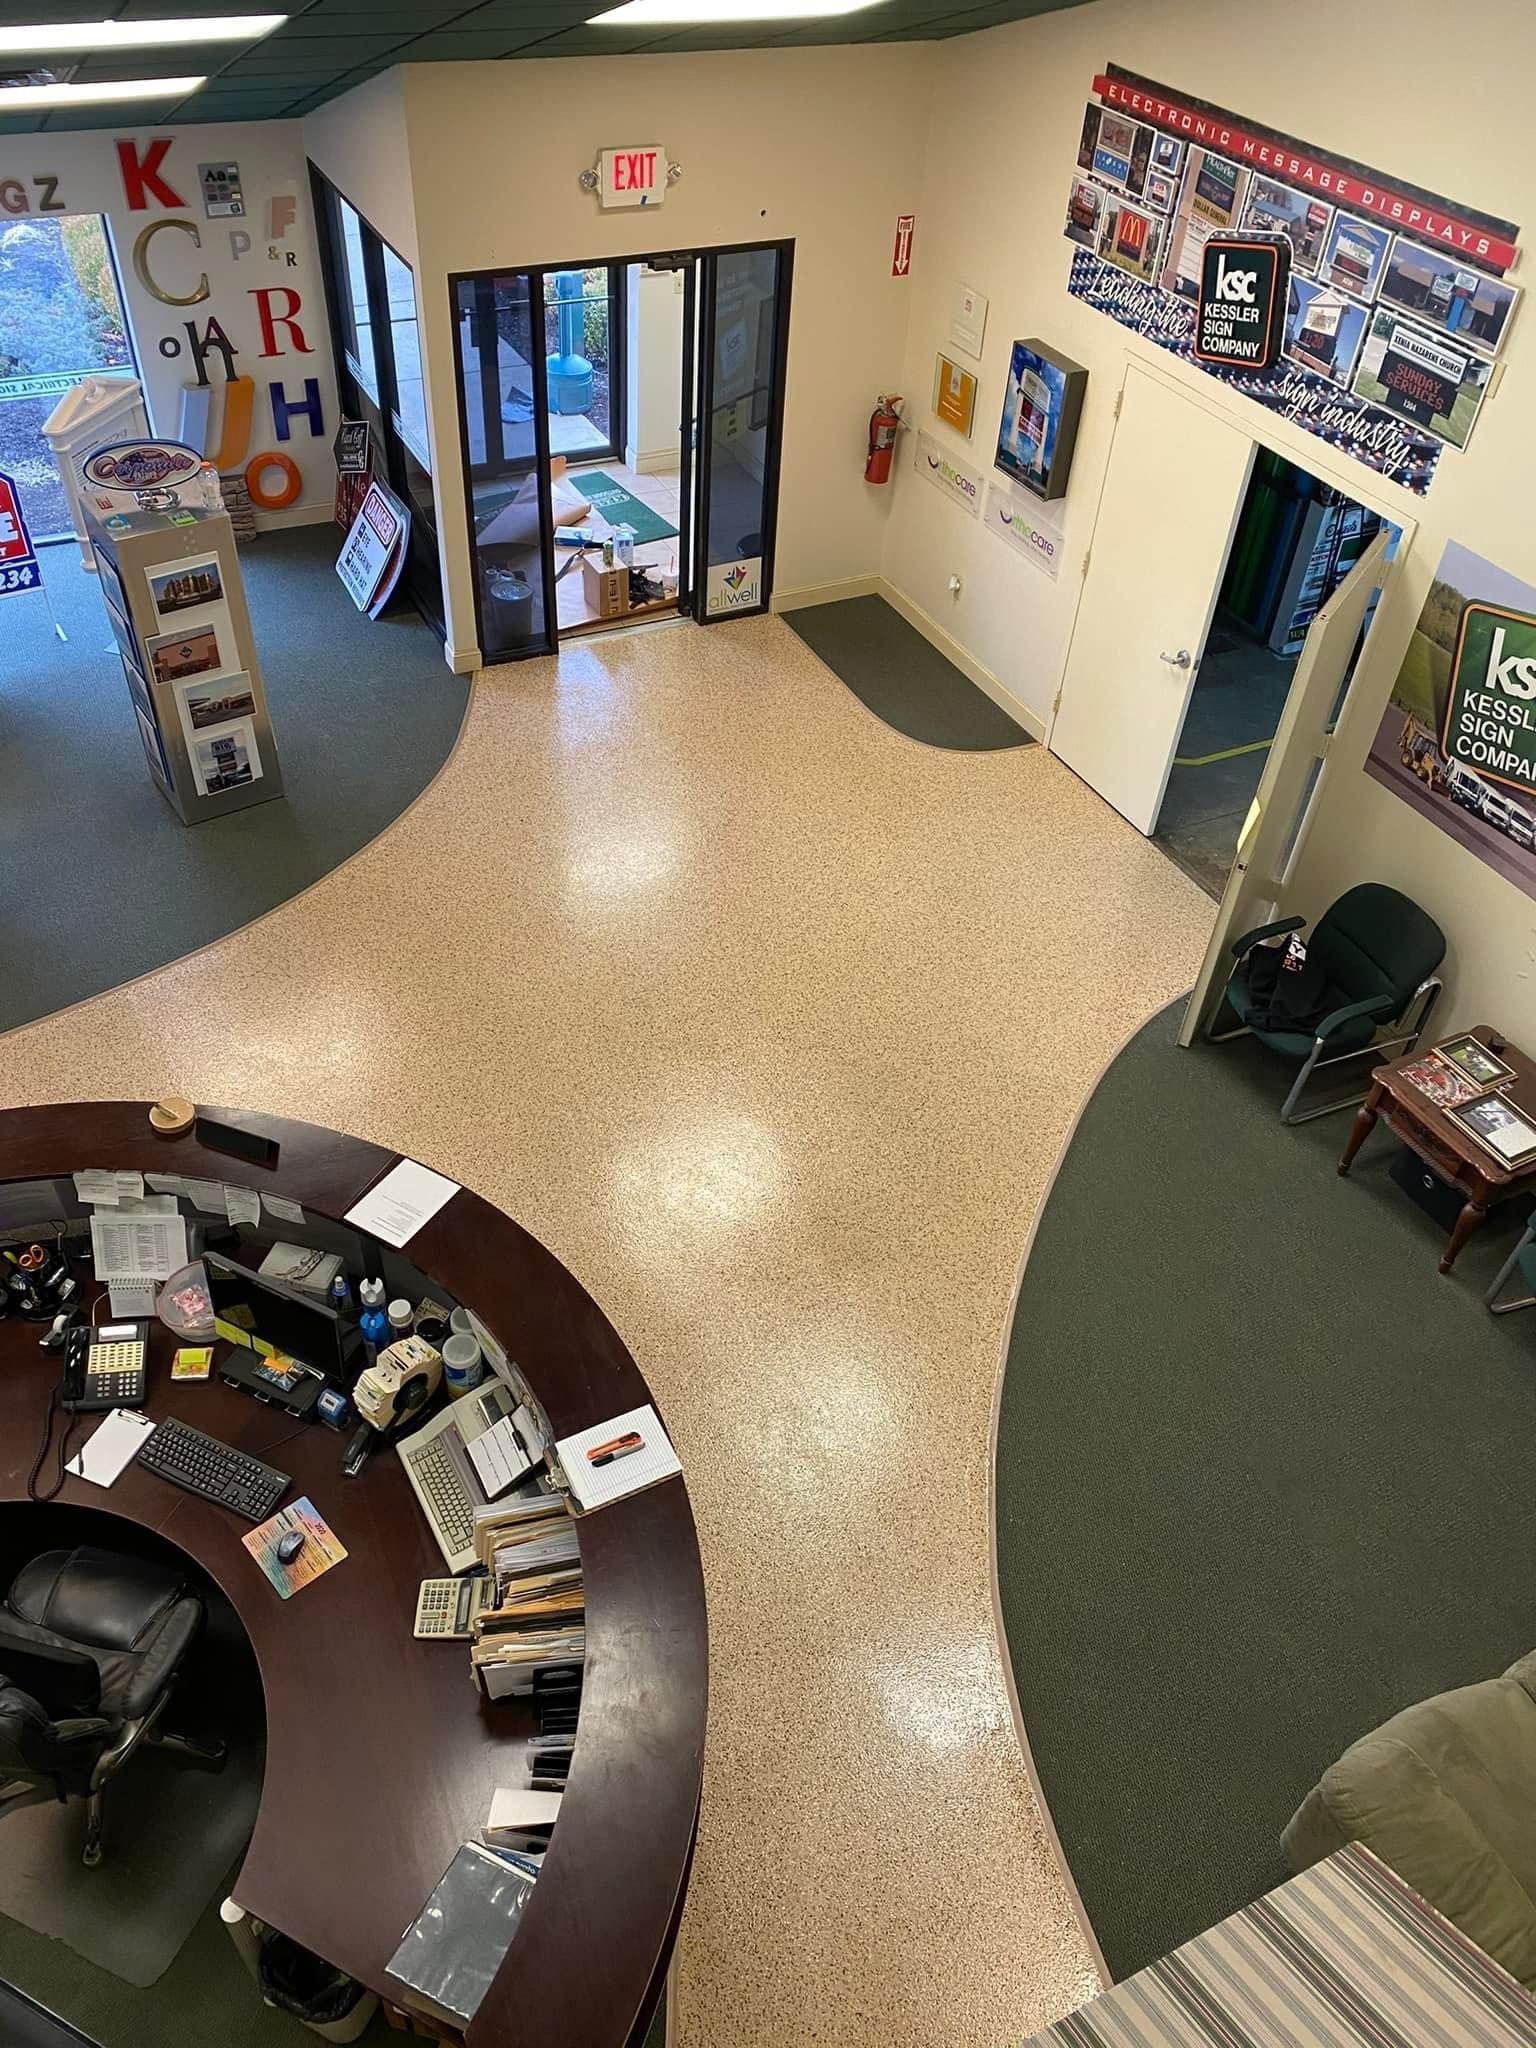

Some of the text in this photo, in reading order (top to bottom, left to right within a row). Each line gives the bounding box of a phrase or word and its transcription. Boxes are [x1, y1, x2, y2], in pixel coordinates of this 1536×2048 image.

[114, 137, 188, 210] K
[613, 152, 657, 191] EXIT
[1109, 83, 1231, 146] ELECTRONIC
[1243, 140, 1348, 196] MESSAGE
[1362, 189, 1491, 255] DISPLAYS
[33, 176, 65, 211] Z
[133, 218, 211, 306] C
[1087, 262, 1188, 337] Leading the
[1204, 302, 1260, 323] KESSLER
[248, 287, 317, 358] R
[1203, 320, 1233, 337] SIGN
[1202, 336, 1260, 358] COMPANY
[1278, 373, 1320, 421] sign
[1386, 372, 1445, 410] SERVICES
[1395, 363, 1442, 393] SUNDAY
[269, 378, 325, 441] H
[364, 497, 397, 543] DANGER
[709, 581, 758, 609] allwell
[1459, 712, 1515, 748] SIGN
[1463, 689, 1536, 733] KESSL
